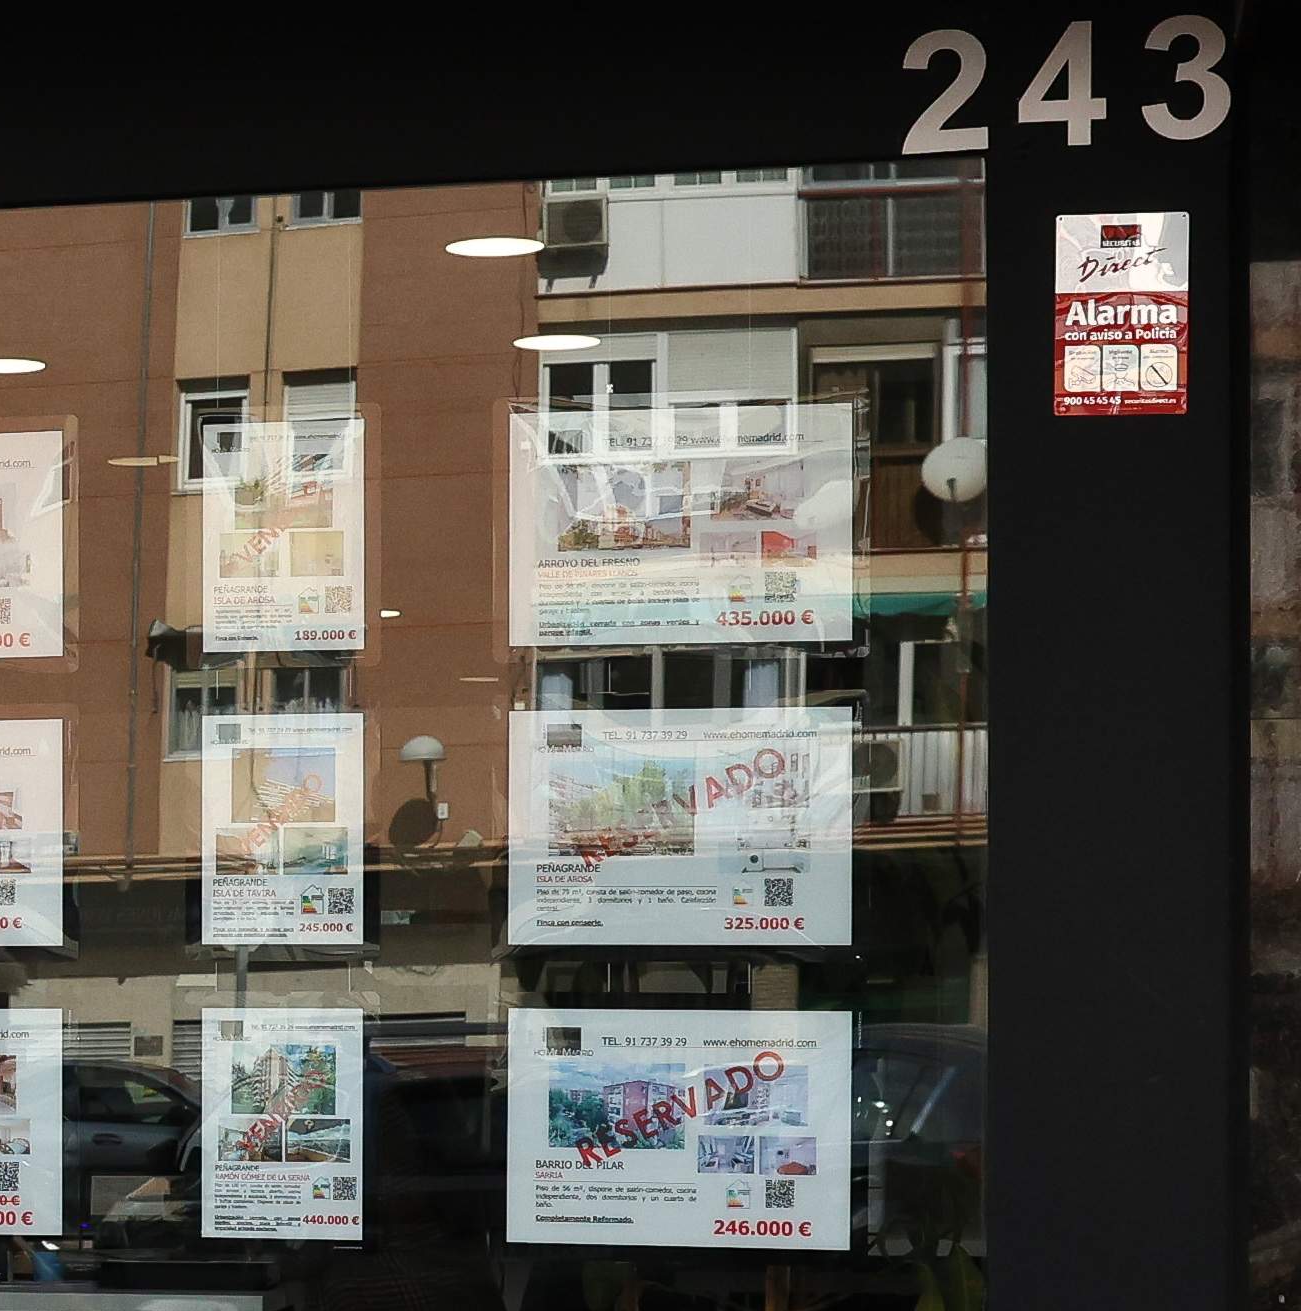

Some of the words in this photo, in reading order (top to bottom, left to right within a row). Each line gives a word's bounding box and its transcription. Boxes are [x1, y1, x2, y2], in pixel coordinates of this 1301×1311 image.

[902, 14, 1232, 155] 243
[1078, 248, 1167, 282] Direct
[1065, 299, 1177, 326] Alarma
[1065, 330, 1087, 340] con
[1090, 329, 1122, 340] aviso
[1125, 331, 1132, 340] a
[1064, 397, 1082, 405] 900
[1084, 396, 1095, 405] 45
[1097, 396, 1108, 404] 45
[1109, 395, 1121, 404] 45
[538, 558, 578, 568] ARROYO
[580, 558, 598, 568] DEL
[602, 557, 640, 567] FRESNO
[214, 584, 268, 594] PEÑAGRANDE
[234, 596, 246, 604] DE
[715, 610, 796, 627] 435.000
[800, 610, 814, 624] €
[19, 633, 31, 647] €
[294, 630, 345, 640] 189.000
[348, 629, 357, 640] €
[604, 731, 623, 740] TEL.
[626, 730, 638, 740] 91
[641, 730, 658, 740] 737
[662, 730, 672, 740] 39
[677, 730, 688, 739] 29
[703, 729, 817, 740] www.ehomemadrid.com
[537, 864, 601, 873] PEÑAGRANDE
[213, 876, 268, 887] PEÑAGRANDE
[213, 889, 231, 897] ISLA
[233, 889, 245, 897] DE
[247, 889, 276, 897] TAVIRA
[13, 917, 23, 929] €
[299, 923, 343, 932] 245.000
[346, 923, 353, 932] €
[724, 917, 789, 931] 325.000
[794, 917, 805, 931] €
[602, 1037, 622, 1046] TEL.
[625, 1037, 637, 1046] 91
[641, 1037, 658, 1047] 737
[661, 1037, 672, 1047] 39
[676, 1037, 687, 1047] 29
[703, 1038, 817, 1049] www.ehomemadrid.com
[577, 1051, 784, 1167] RESERVADO
[215, 1164, 260, 1172] PEÑAGRANDE
[536, 1160, 572, 1169] BARRIO
[596, 1162, 624, 1170] PILAR
[21, 1211, 33, 1226] €
[302, 1215, 349, 1225] 440.000
[351, 1215, 360, 1225] €
[713, 1220, 794, 1237] 246.000
[798, 1222, 812, 1236] €
